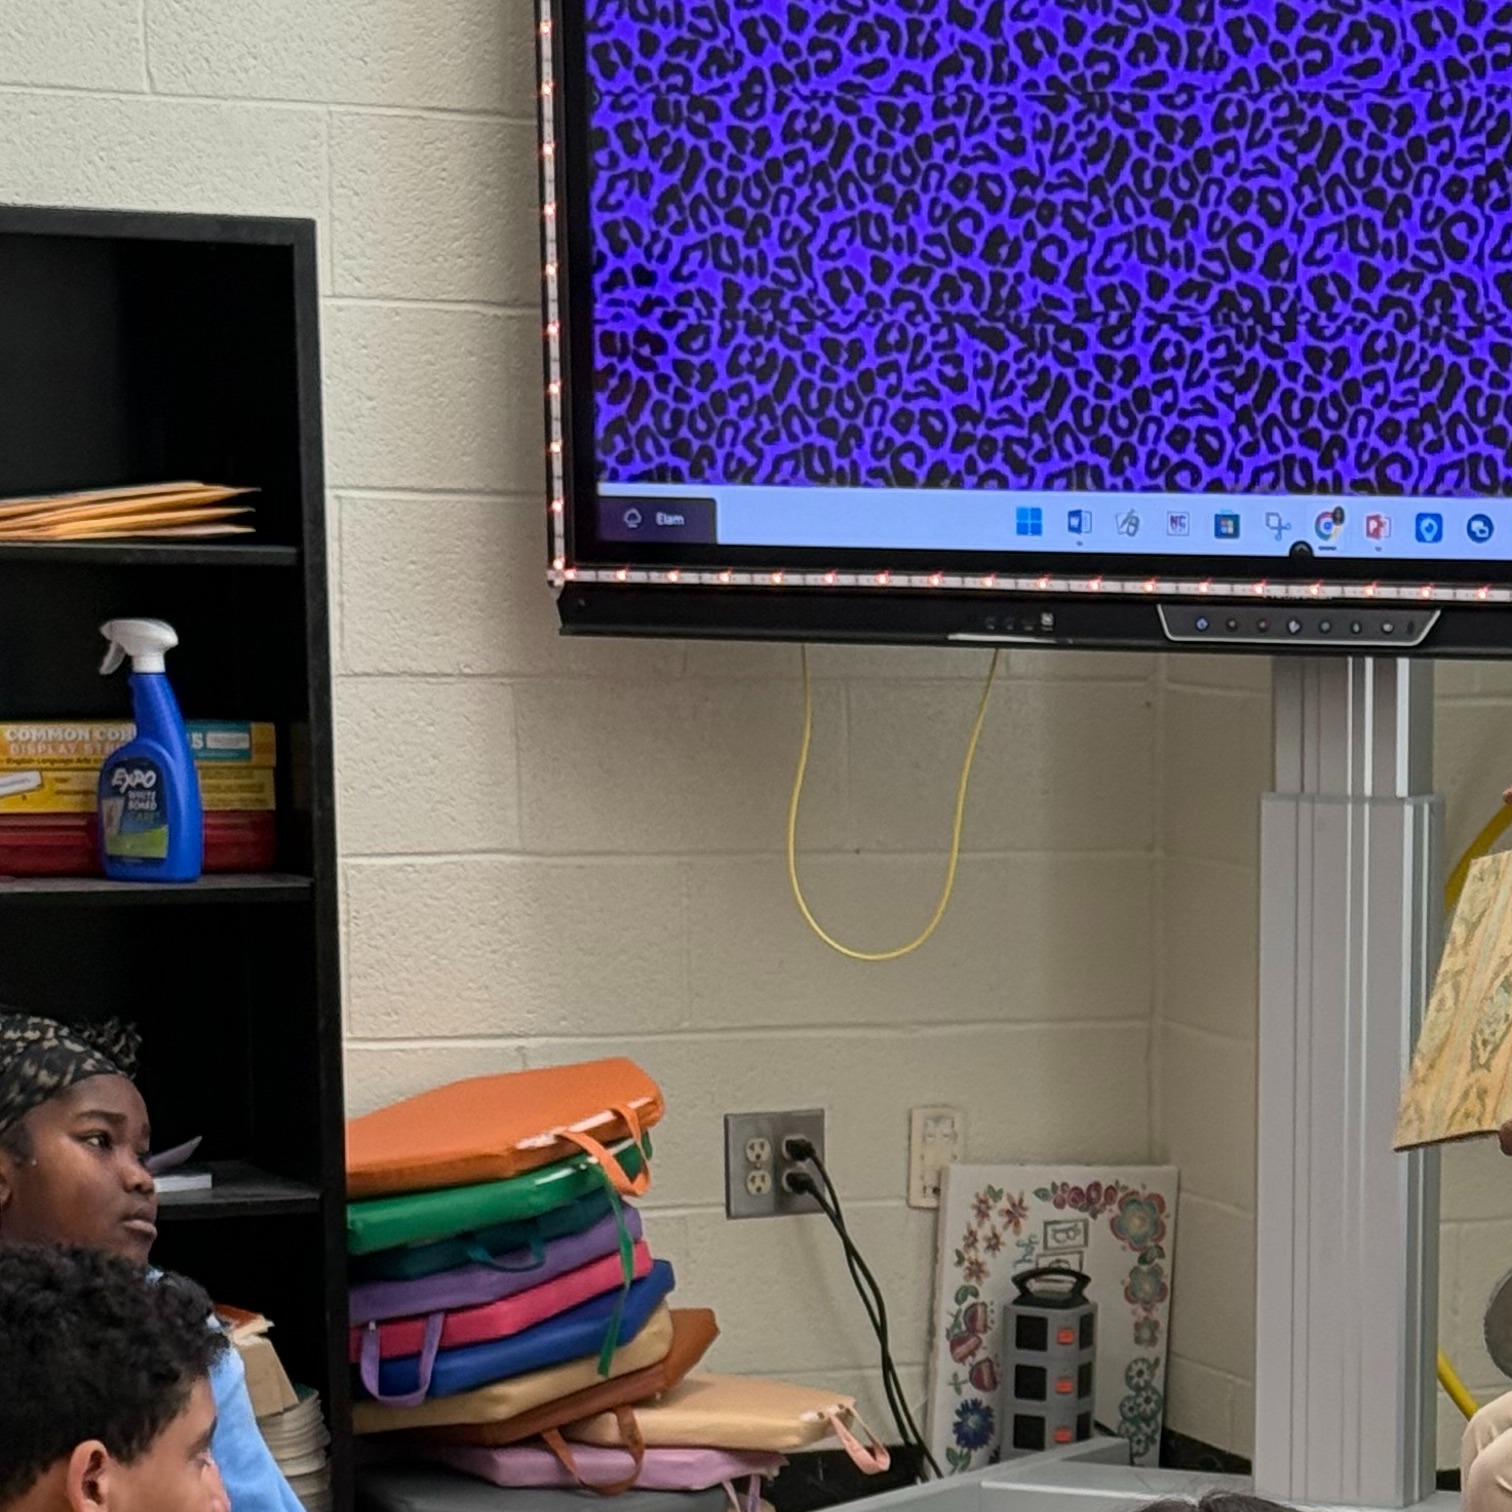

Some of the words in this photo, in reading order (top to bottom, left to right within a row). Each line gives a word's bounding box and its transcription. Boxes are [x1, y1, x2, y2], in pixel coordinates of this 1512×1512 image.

[7, 727, 91, 742] COMMON
[95, 727, 137, 742] COR
[112, 767, 157, 794] EXPO
